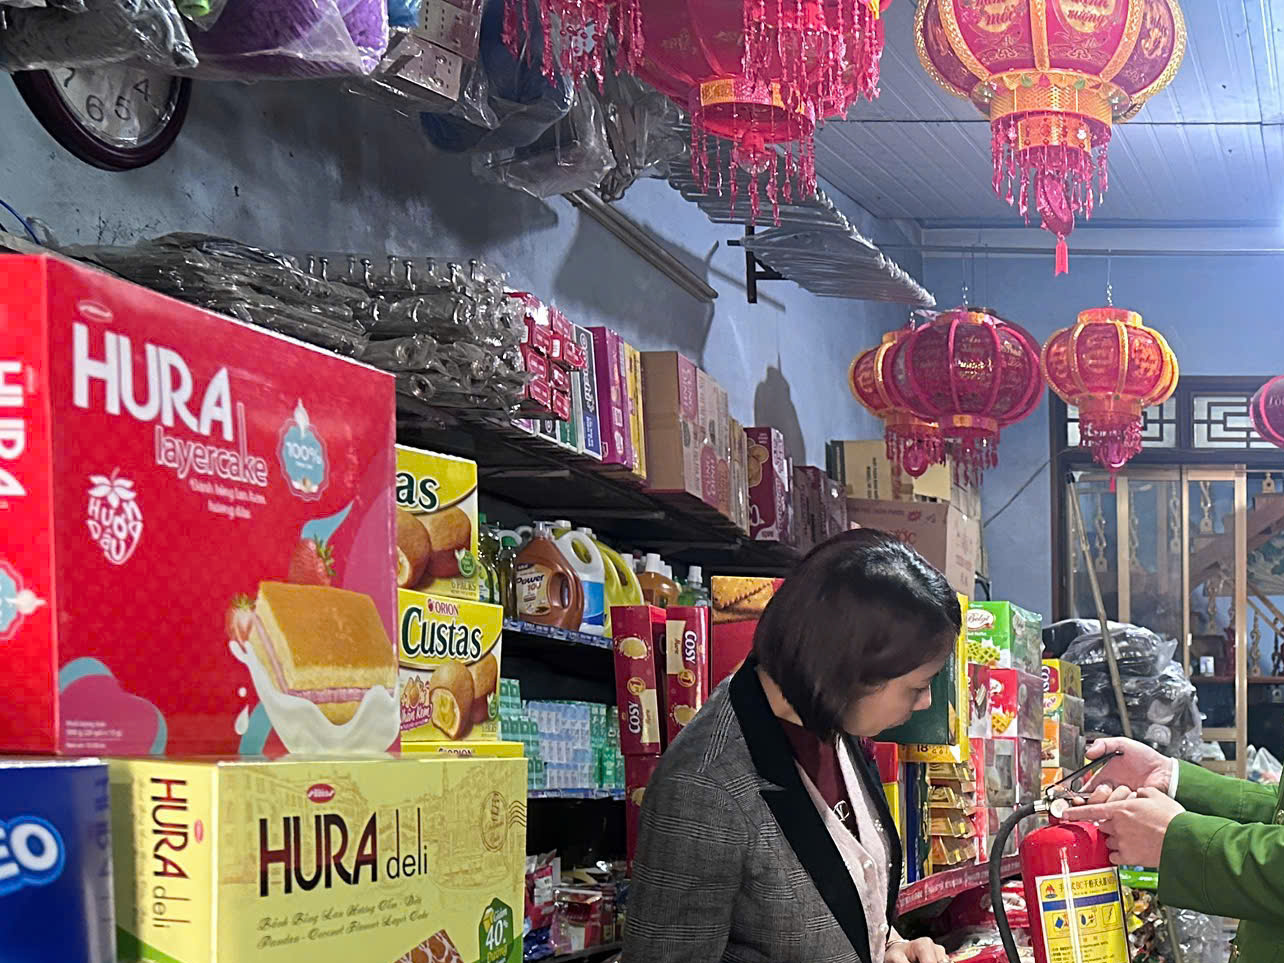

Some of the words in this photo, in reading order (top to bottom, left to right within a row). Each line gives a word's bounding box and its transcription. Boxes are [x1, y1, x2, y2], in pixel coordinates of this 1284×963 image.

[85, 94, 104, 122] 6
[114, 95, 131, 121] 5
[134, 78, 151, 102] 4
[72, 321, 233, 442] HURA
[155, 402, 268, 487] layercake
[434, 600, 459, 616] ORION
[401, 606, 482, 659] Custas
[685, 630, 697, 664] COSY
[629, 701, 641, 734] COSY
[150, 777, 189, 879] HURA
[259, 812, 378, 898] HURA
[387, 807, 428, 880] deli
[153, 884, 190, 928] deli
